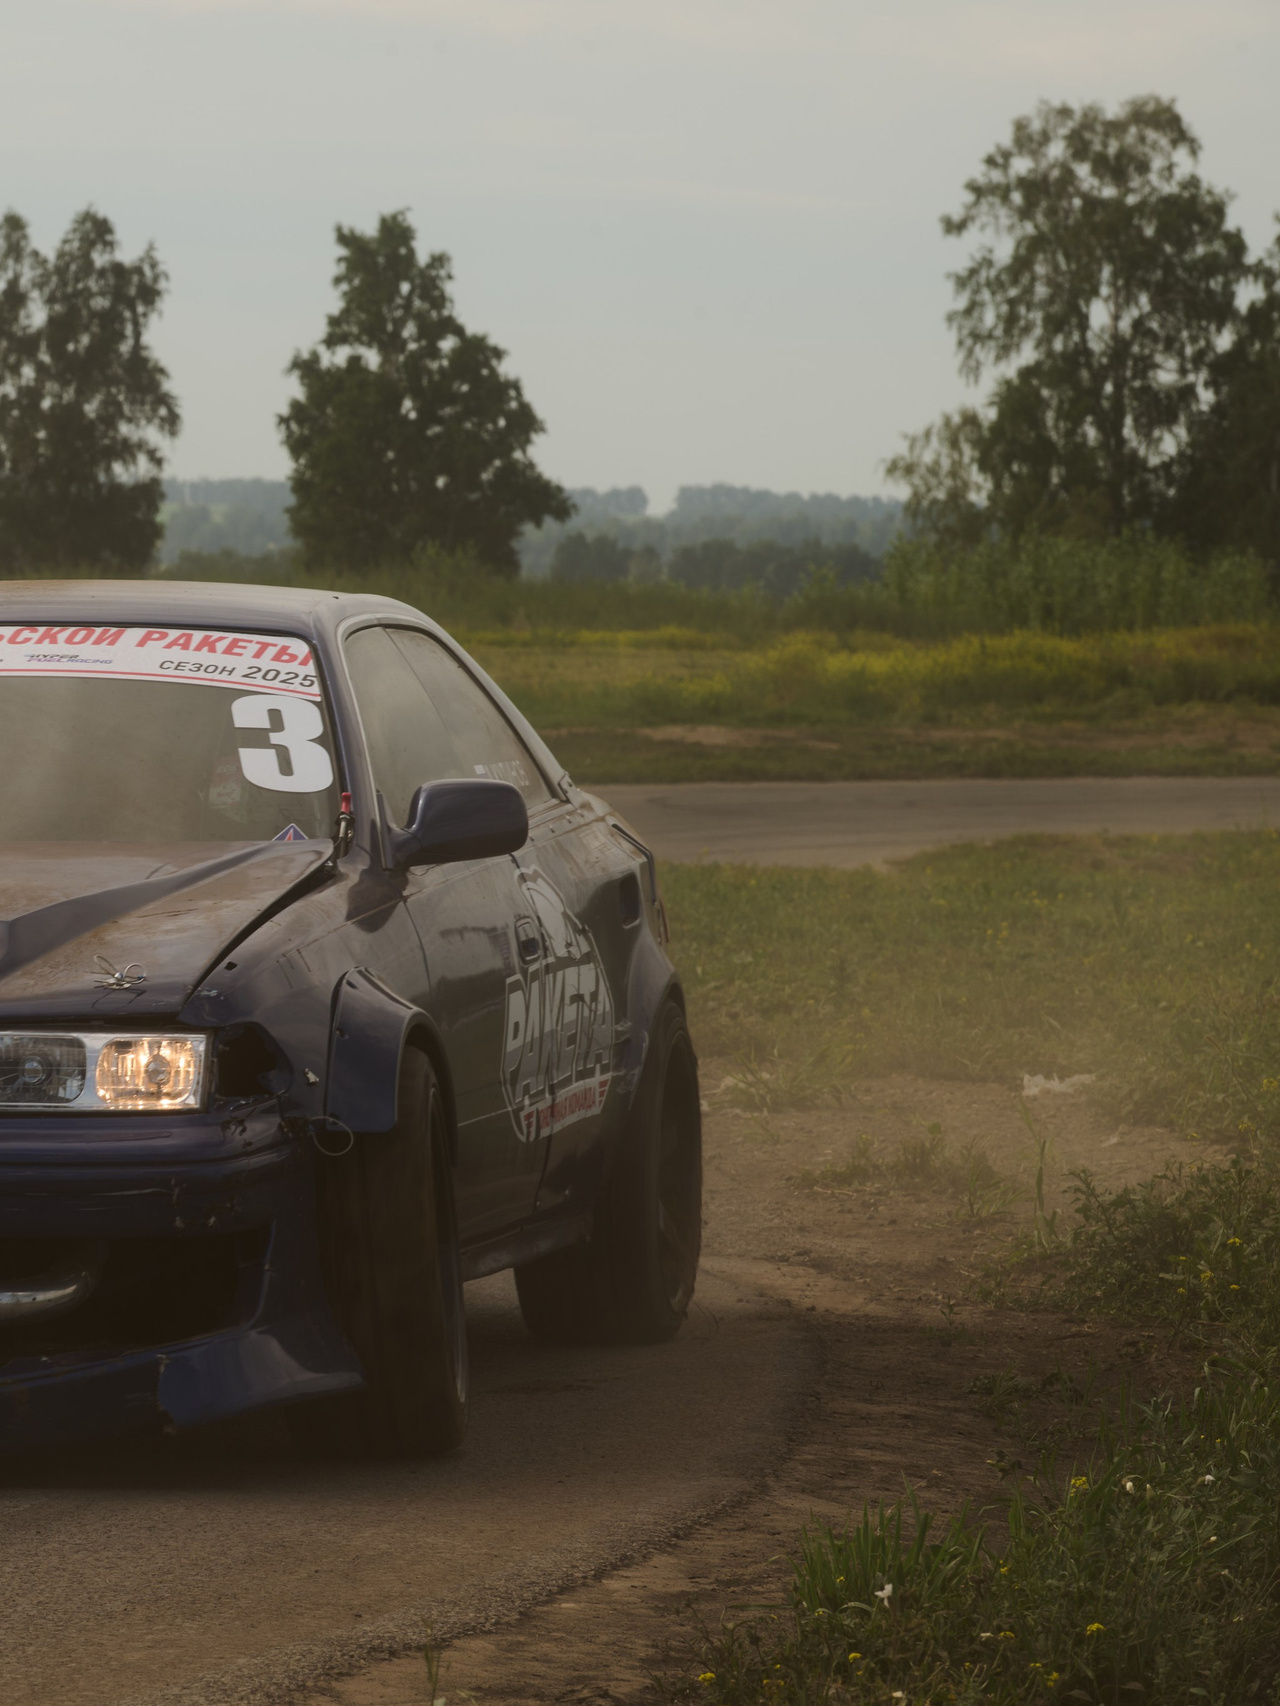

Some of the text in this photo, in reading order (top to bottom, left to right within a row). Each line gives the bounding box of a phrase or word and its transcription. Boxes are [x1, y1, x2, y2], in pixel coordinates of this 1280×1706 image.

[135, 630, 313, 667] РАКЕТЫ
[158, 660, 317, 687] СЕЗОН 2025
[231, 695, 334, 793] 3
[504, 963, 613, 1104] РАКЕТА
